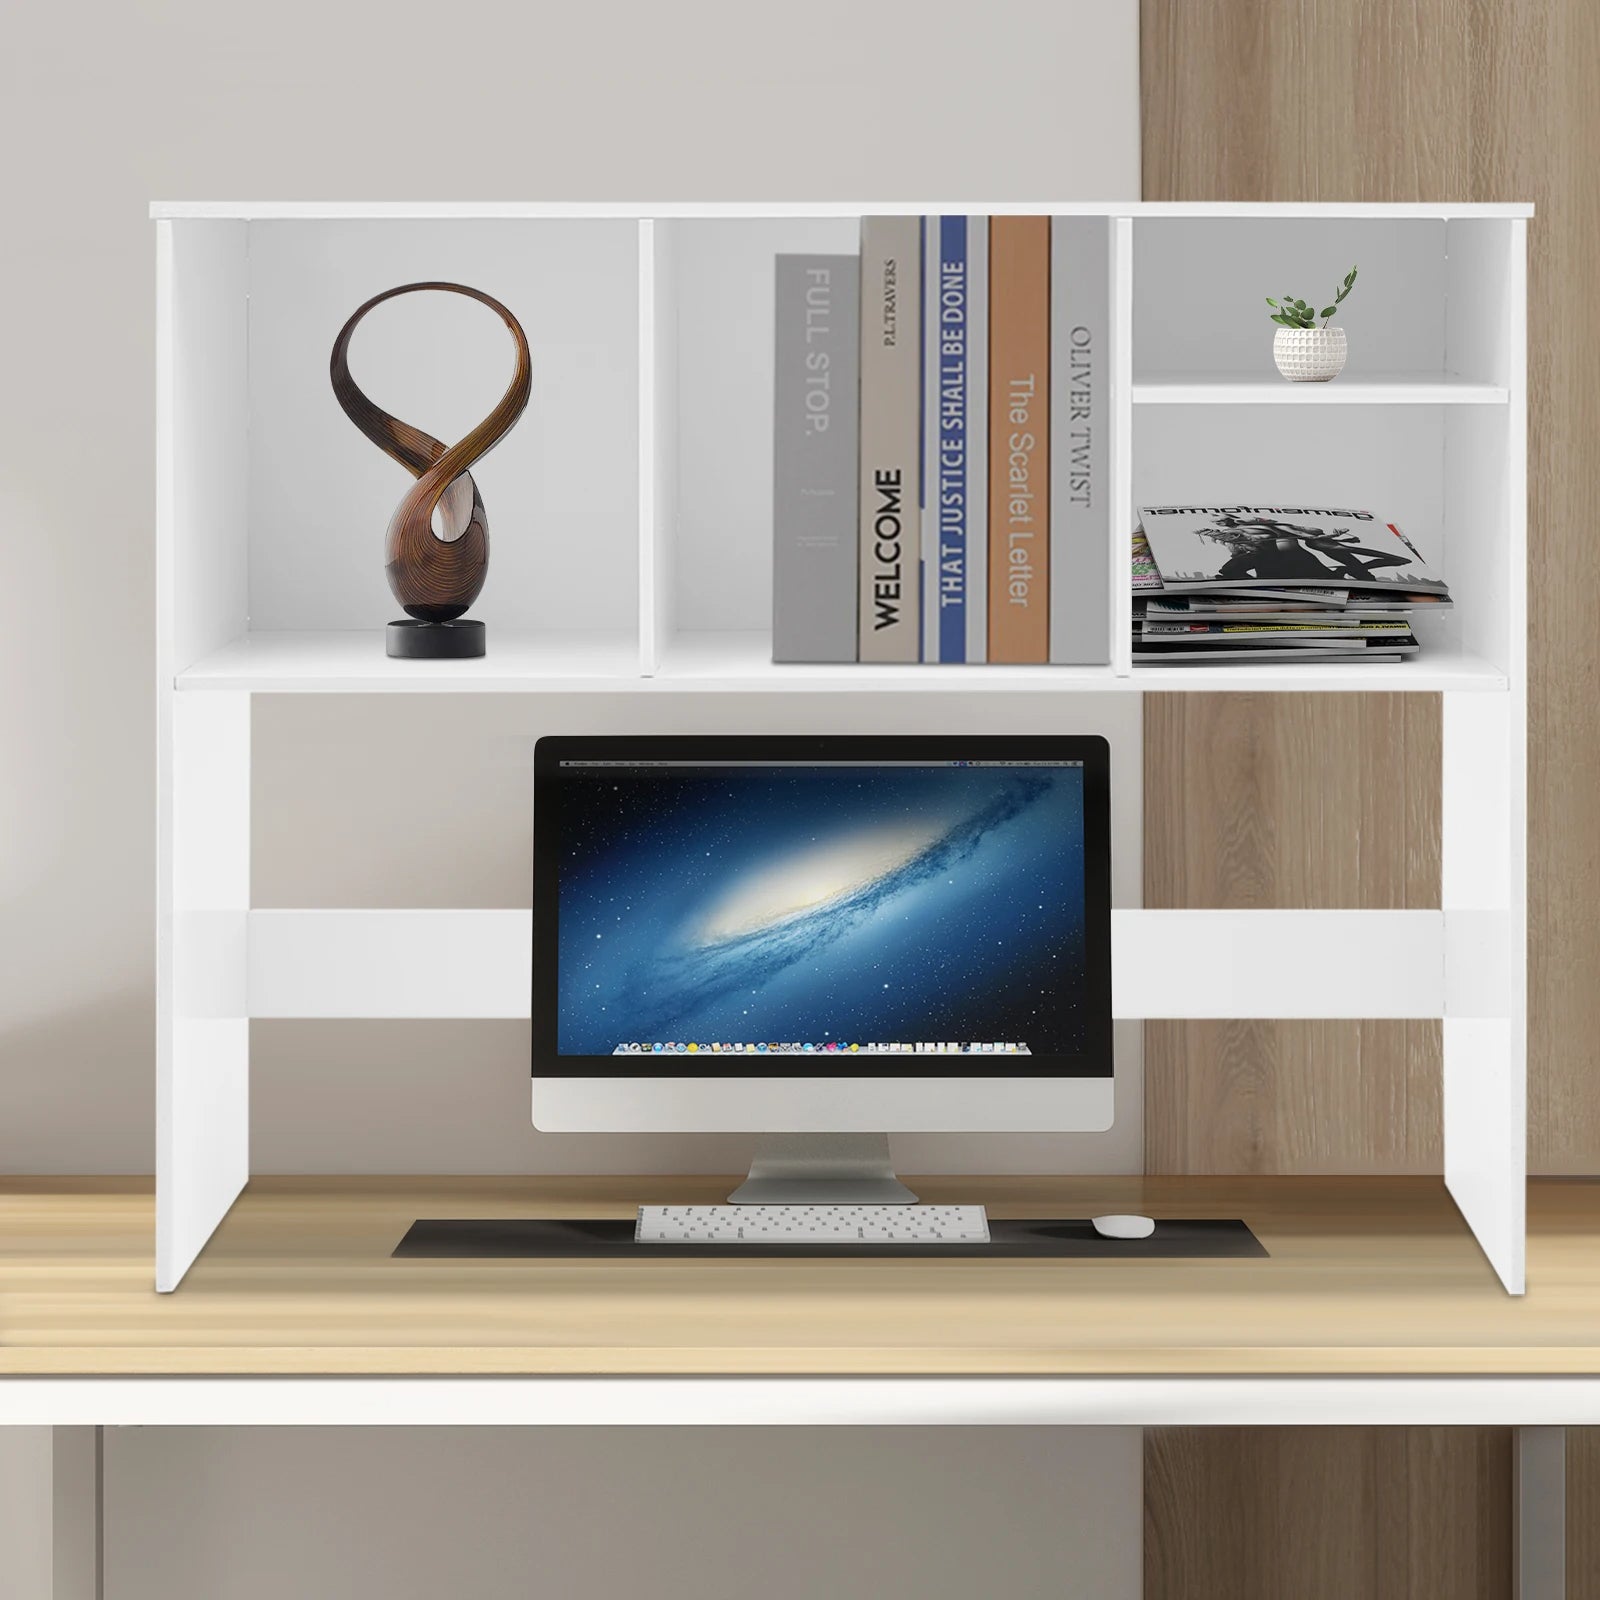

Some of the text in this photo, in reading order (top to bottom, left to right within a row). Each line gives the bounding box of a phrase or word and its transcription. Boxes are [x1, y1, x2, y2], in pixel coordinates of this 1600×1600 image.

[805, 269, 830, 436] FULL STOP.
[942, 262, 964, 607] THAT JUSTICE SHALL BE DONE
[1069, 326, 1092, 509] OLIVER TWIST
[873, 468, 902, 632] WELCOME
[1008, 374, 1035, 607] The Scarlet Letter
